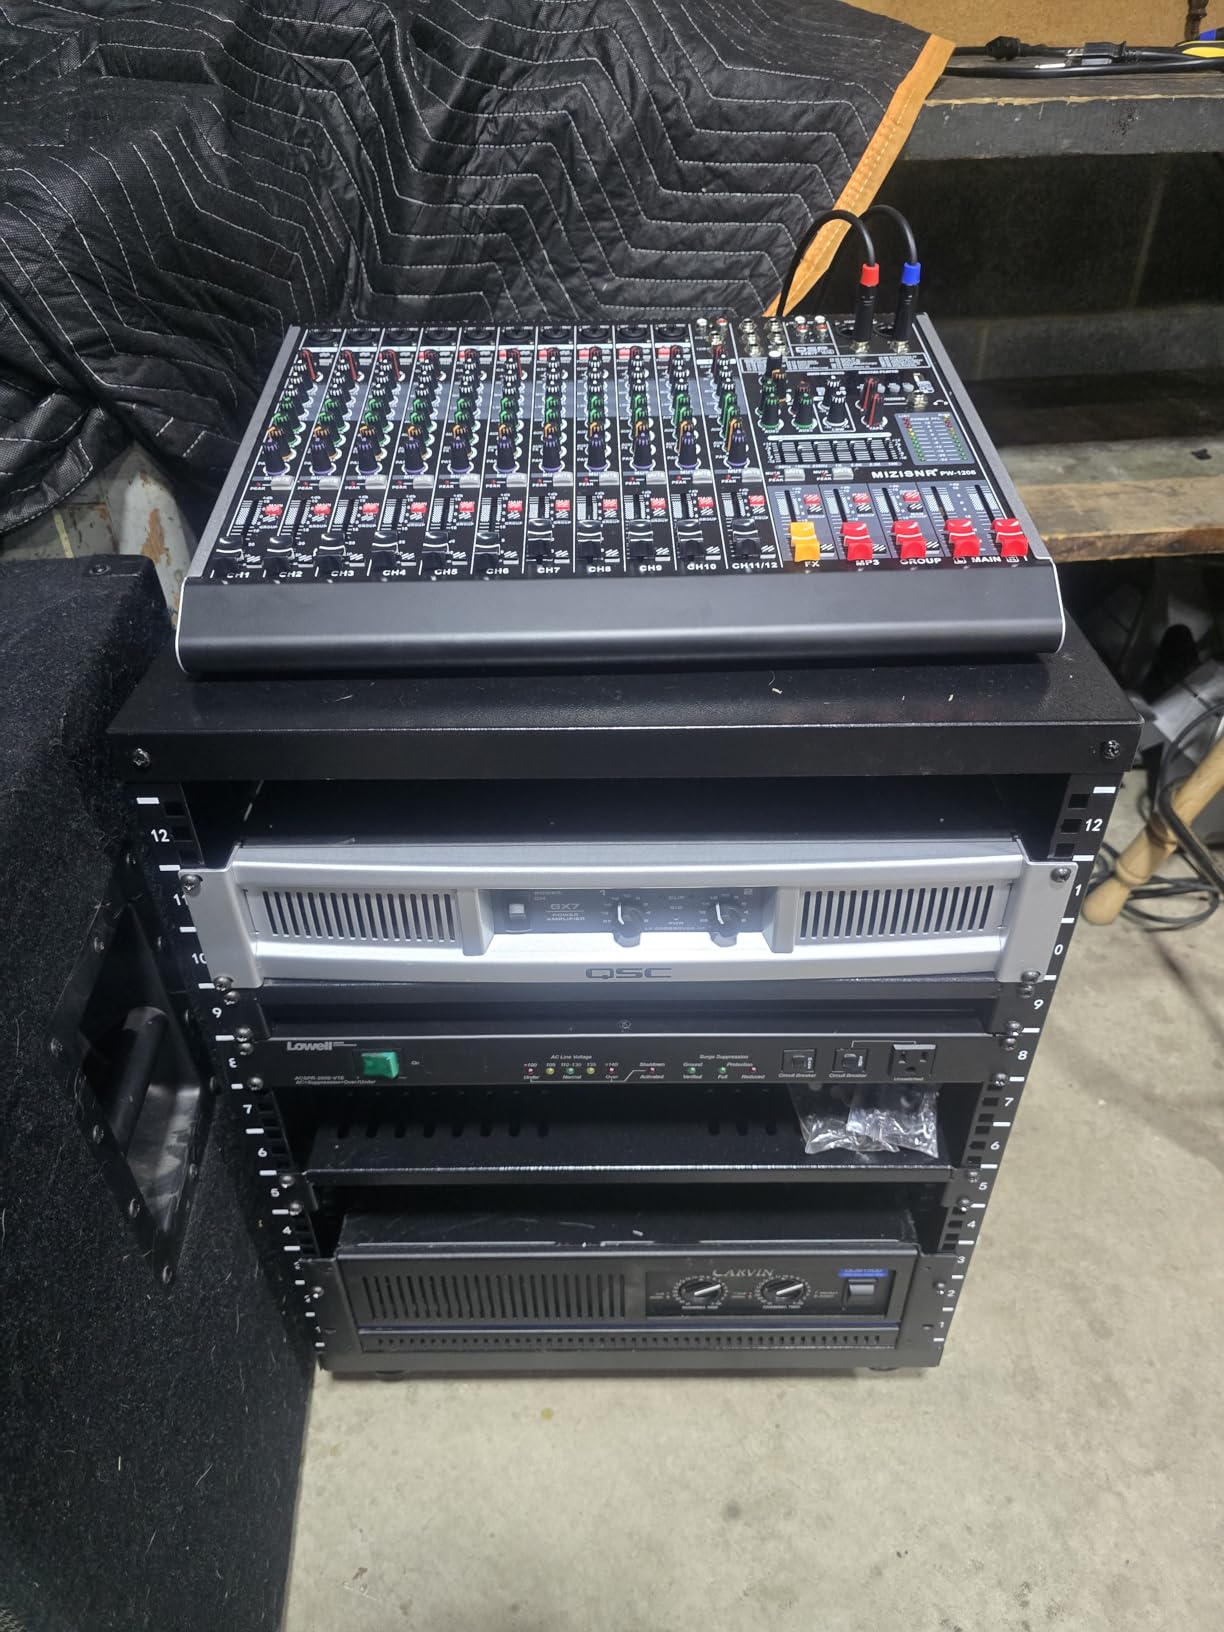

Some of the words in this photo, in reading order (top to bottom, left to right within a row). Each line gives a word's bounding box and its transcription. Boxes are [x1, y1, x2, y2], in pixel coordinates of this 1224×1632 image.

[1085, 819, 1103, 832] 12
[150, 828, 170, 842] 12
[585, 967, 672, 979] QSC
[1034, 999, 1044, 1010] 9
[212, 1007, 222, 1018] 9
[287, 1041, 332, 1051] Lowell
[1018, 1051, 1028, 1060] 8
[1004, 1098, 1014, 1107] 7
[242, 1104, 252, 1114] 7
[990, 1141, 1000, 1150] 6
[258, 1148, 267, 1157] 6
[978, 1182, 988, 1191] 5
[271, 1188, 280, 1198] 5
[967, 1220, 976, 1228] 4
[282, 1226, 292, 1235] 4
